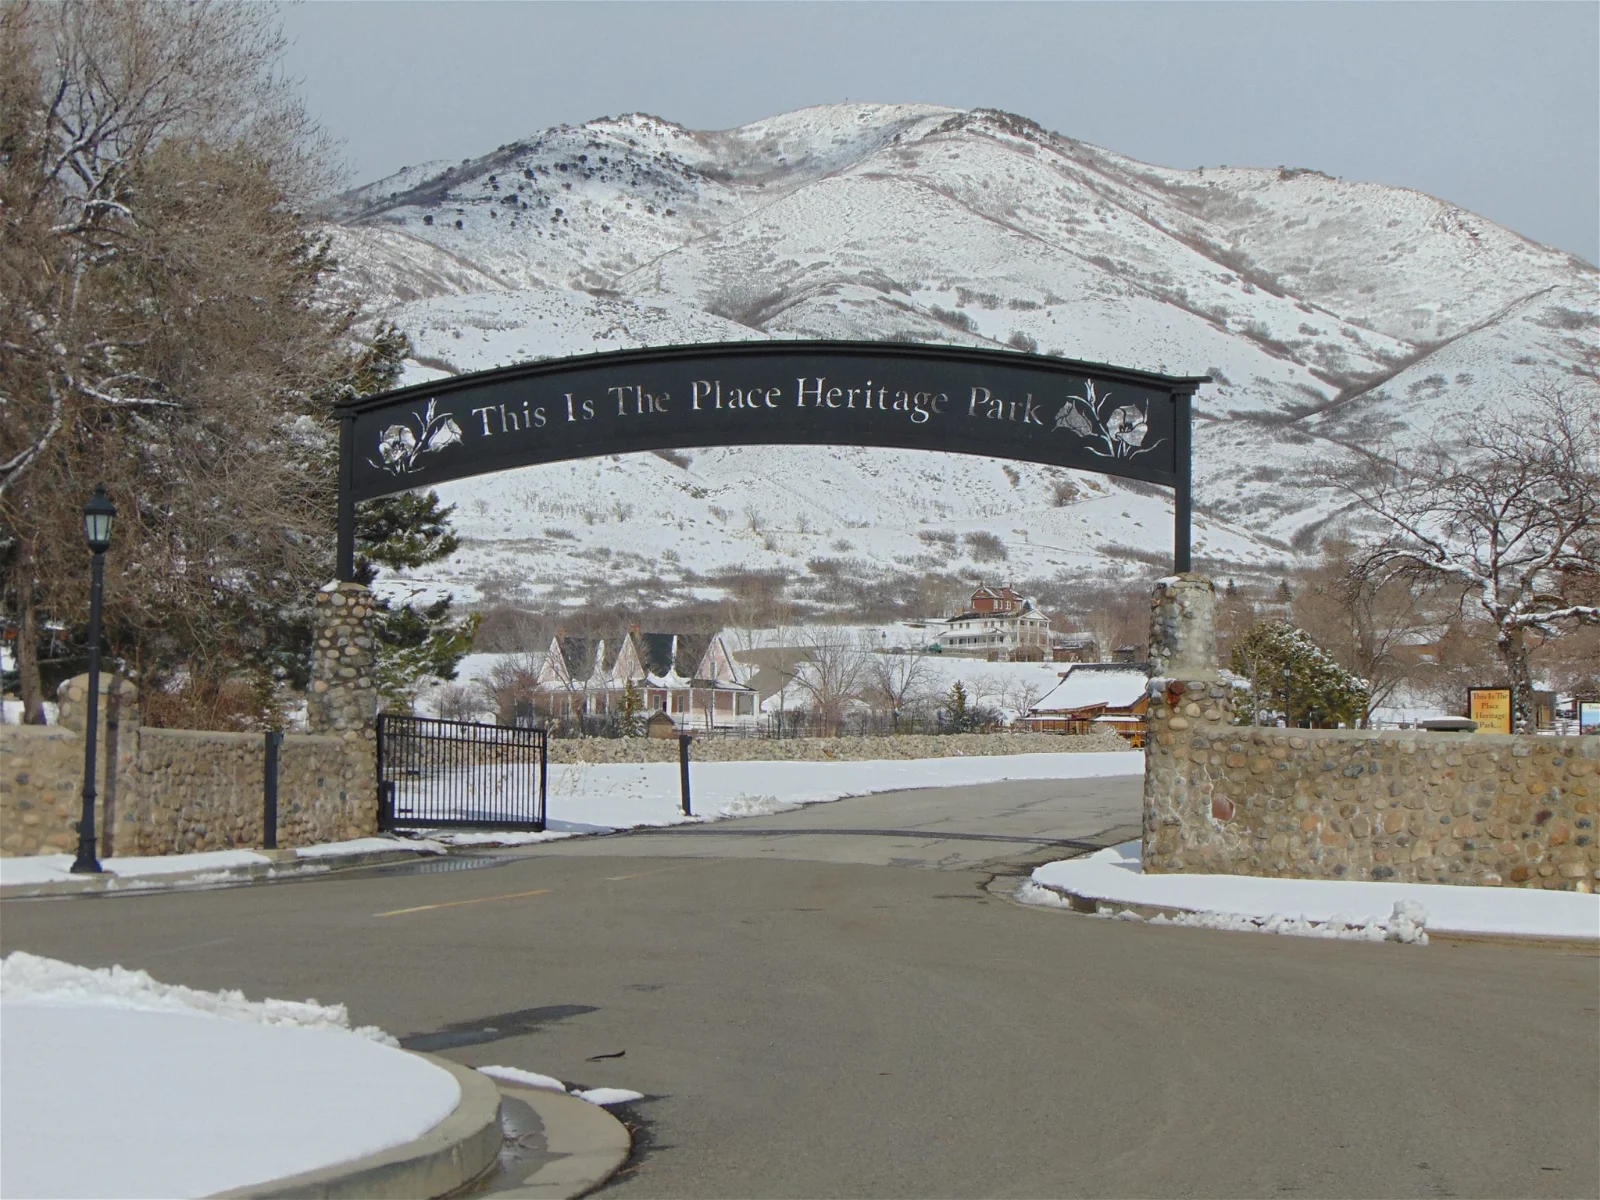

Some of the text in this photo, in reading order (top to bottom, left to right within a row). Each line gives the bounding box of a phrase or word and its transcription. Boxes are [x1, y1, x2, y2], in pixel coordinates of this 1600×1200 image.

[472, 377, 1044, 437] This Is The Place Heritage Park
[1473, 692, 1508, 700] This Is The
[1475, 711, 1505, 720] Heritage
